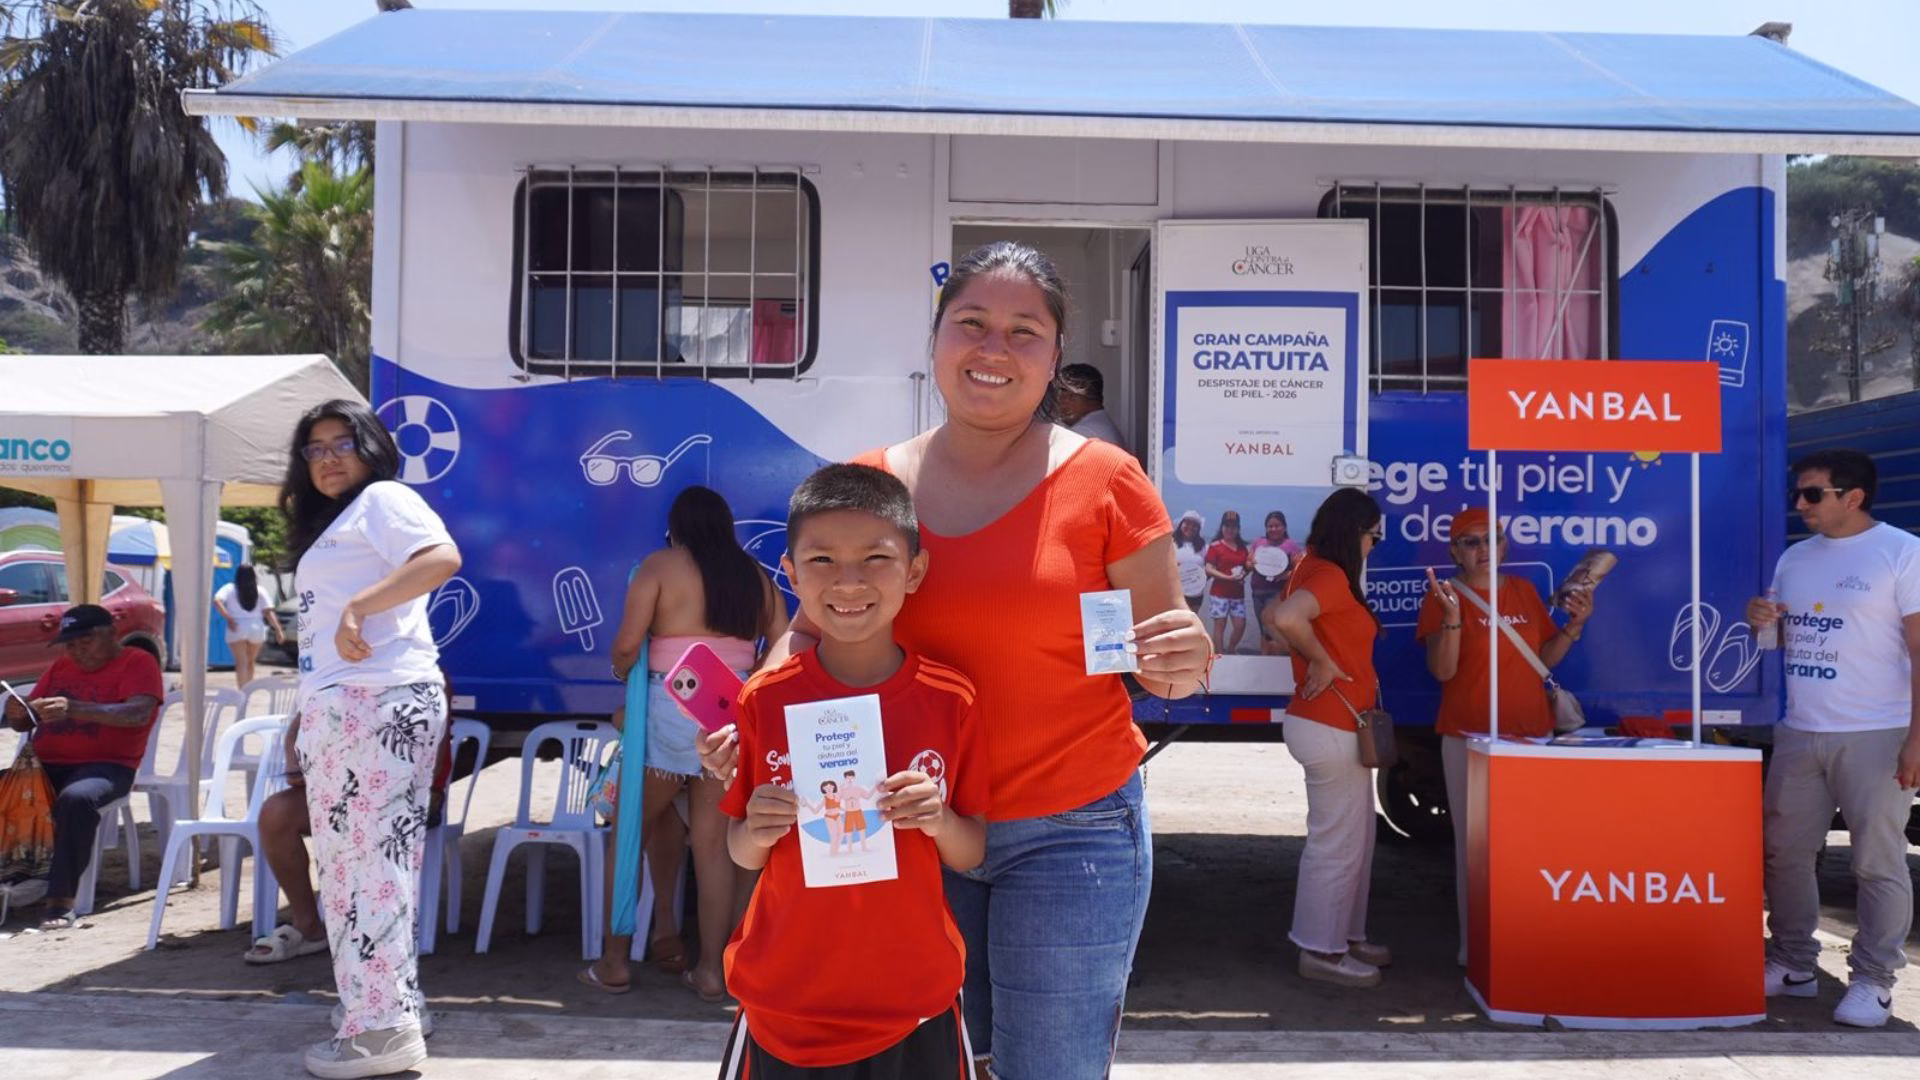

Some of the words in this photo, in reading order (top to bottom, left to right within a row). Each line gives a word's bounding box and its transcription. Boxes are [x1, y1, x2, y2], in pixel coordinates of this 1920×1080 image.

[1245, 245, 1271, 257] LIGA
[1193, 333, 1240, 346] GRAN
[1244, 331, 1329, 347] CAMPAÑA
[1192, 350, 1329, 371] GRATUITA
[1198, 379, 1260, 388] DESPISTAJE
[1263, 380, 1277, 388] DE
[1280, 378, 1323, 389] CÁNCER
[1224, 390, 1238, 398] DE
[1241, 390, 1263, 398] PIEL
[1272, 390, 1297, 399] 2026
[1508, 390, 1682, 421] YANBAL
[1225, 442, 1294, 455] YANBAL
[1517, 454, 1593, 501] piel
[1606, 466, 1632, 503] y
[1401, 503, 1468, 542] de
[1815, 649, 1838, 663] del
[816, 731, 856, 743] Protege
[820, 757, 859, 769] verano
[1539, 868, 1726, 904] YANBAL
